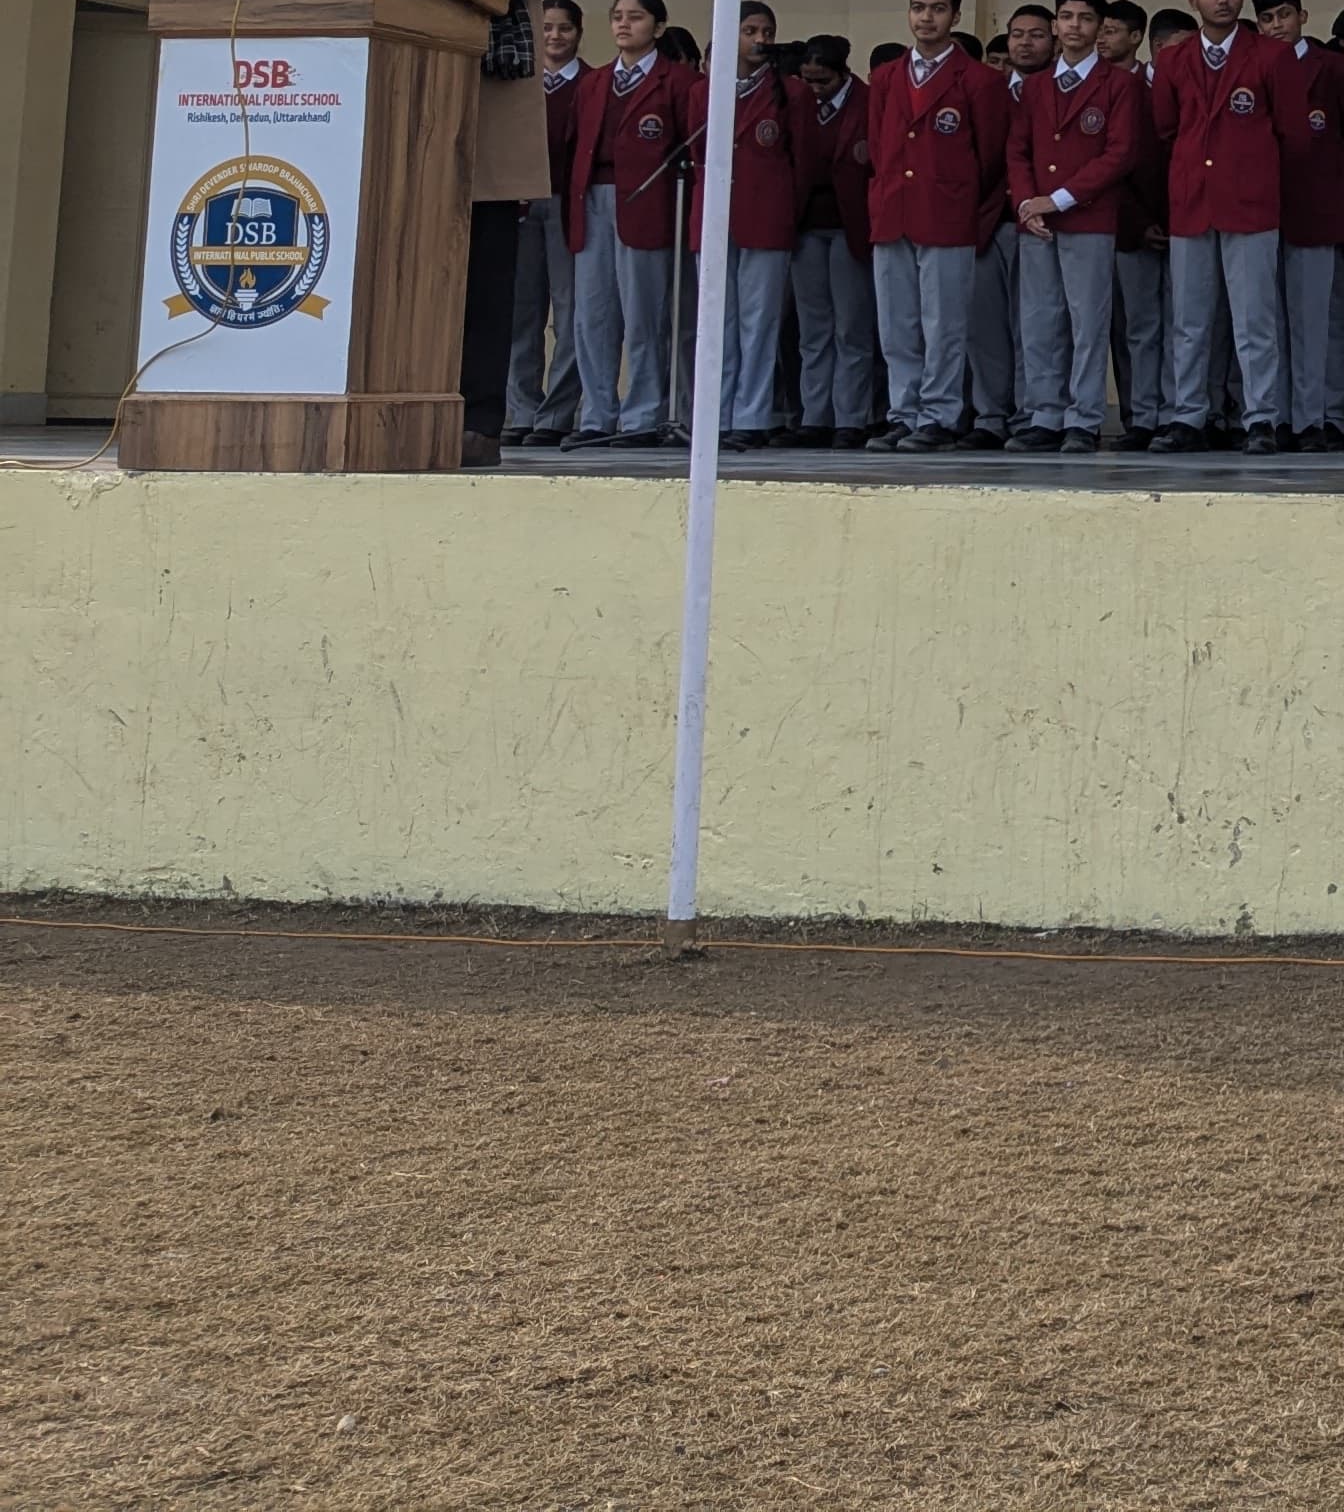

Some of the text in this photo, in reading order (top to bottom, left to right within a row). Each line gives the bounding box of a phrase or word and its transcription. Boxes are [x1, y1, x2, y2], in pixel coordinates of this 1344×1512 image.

[233, 60, 294, 88] DSB
[178, 93, 341, 106] INTERNATIONAL PUBLIC SCHOOL
[187, 112, 228, 124] Rishikesh,
[187, 193, 203, 211] SHRI
[224, 222, 276, 245] DSB
[251, 250, 276, 261] PUBLIC
[276, 250, 304, 261] SCHOOL
